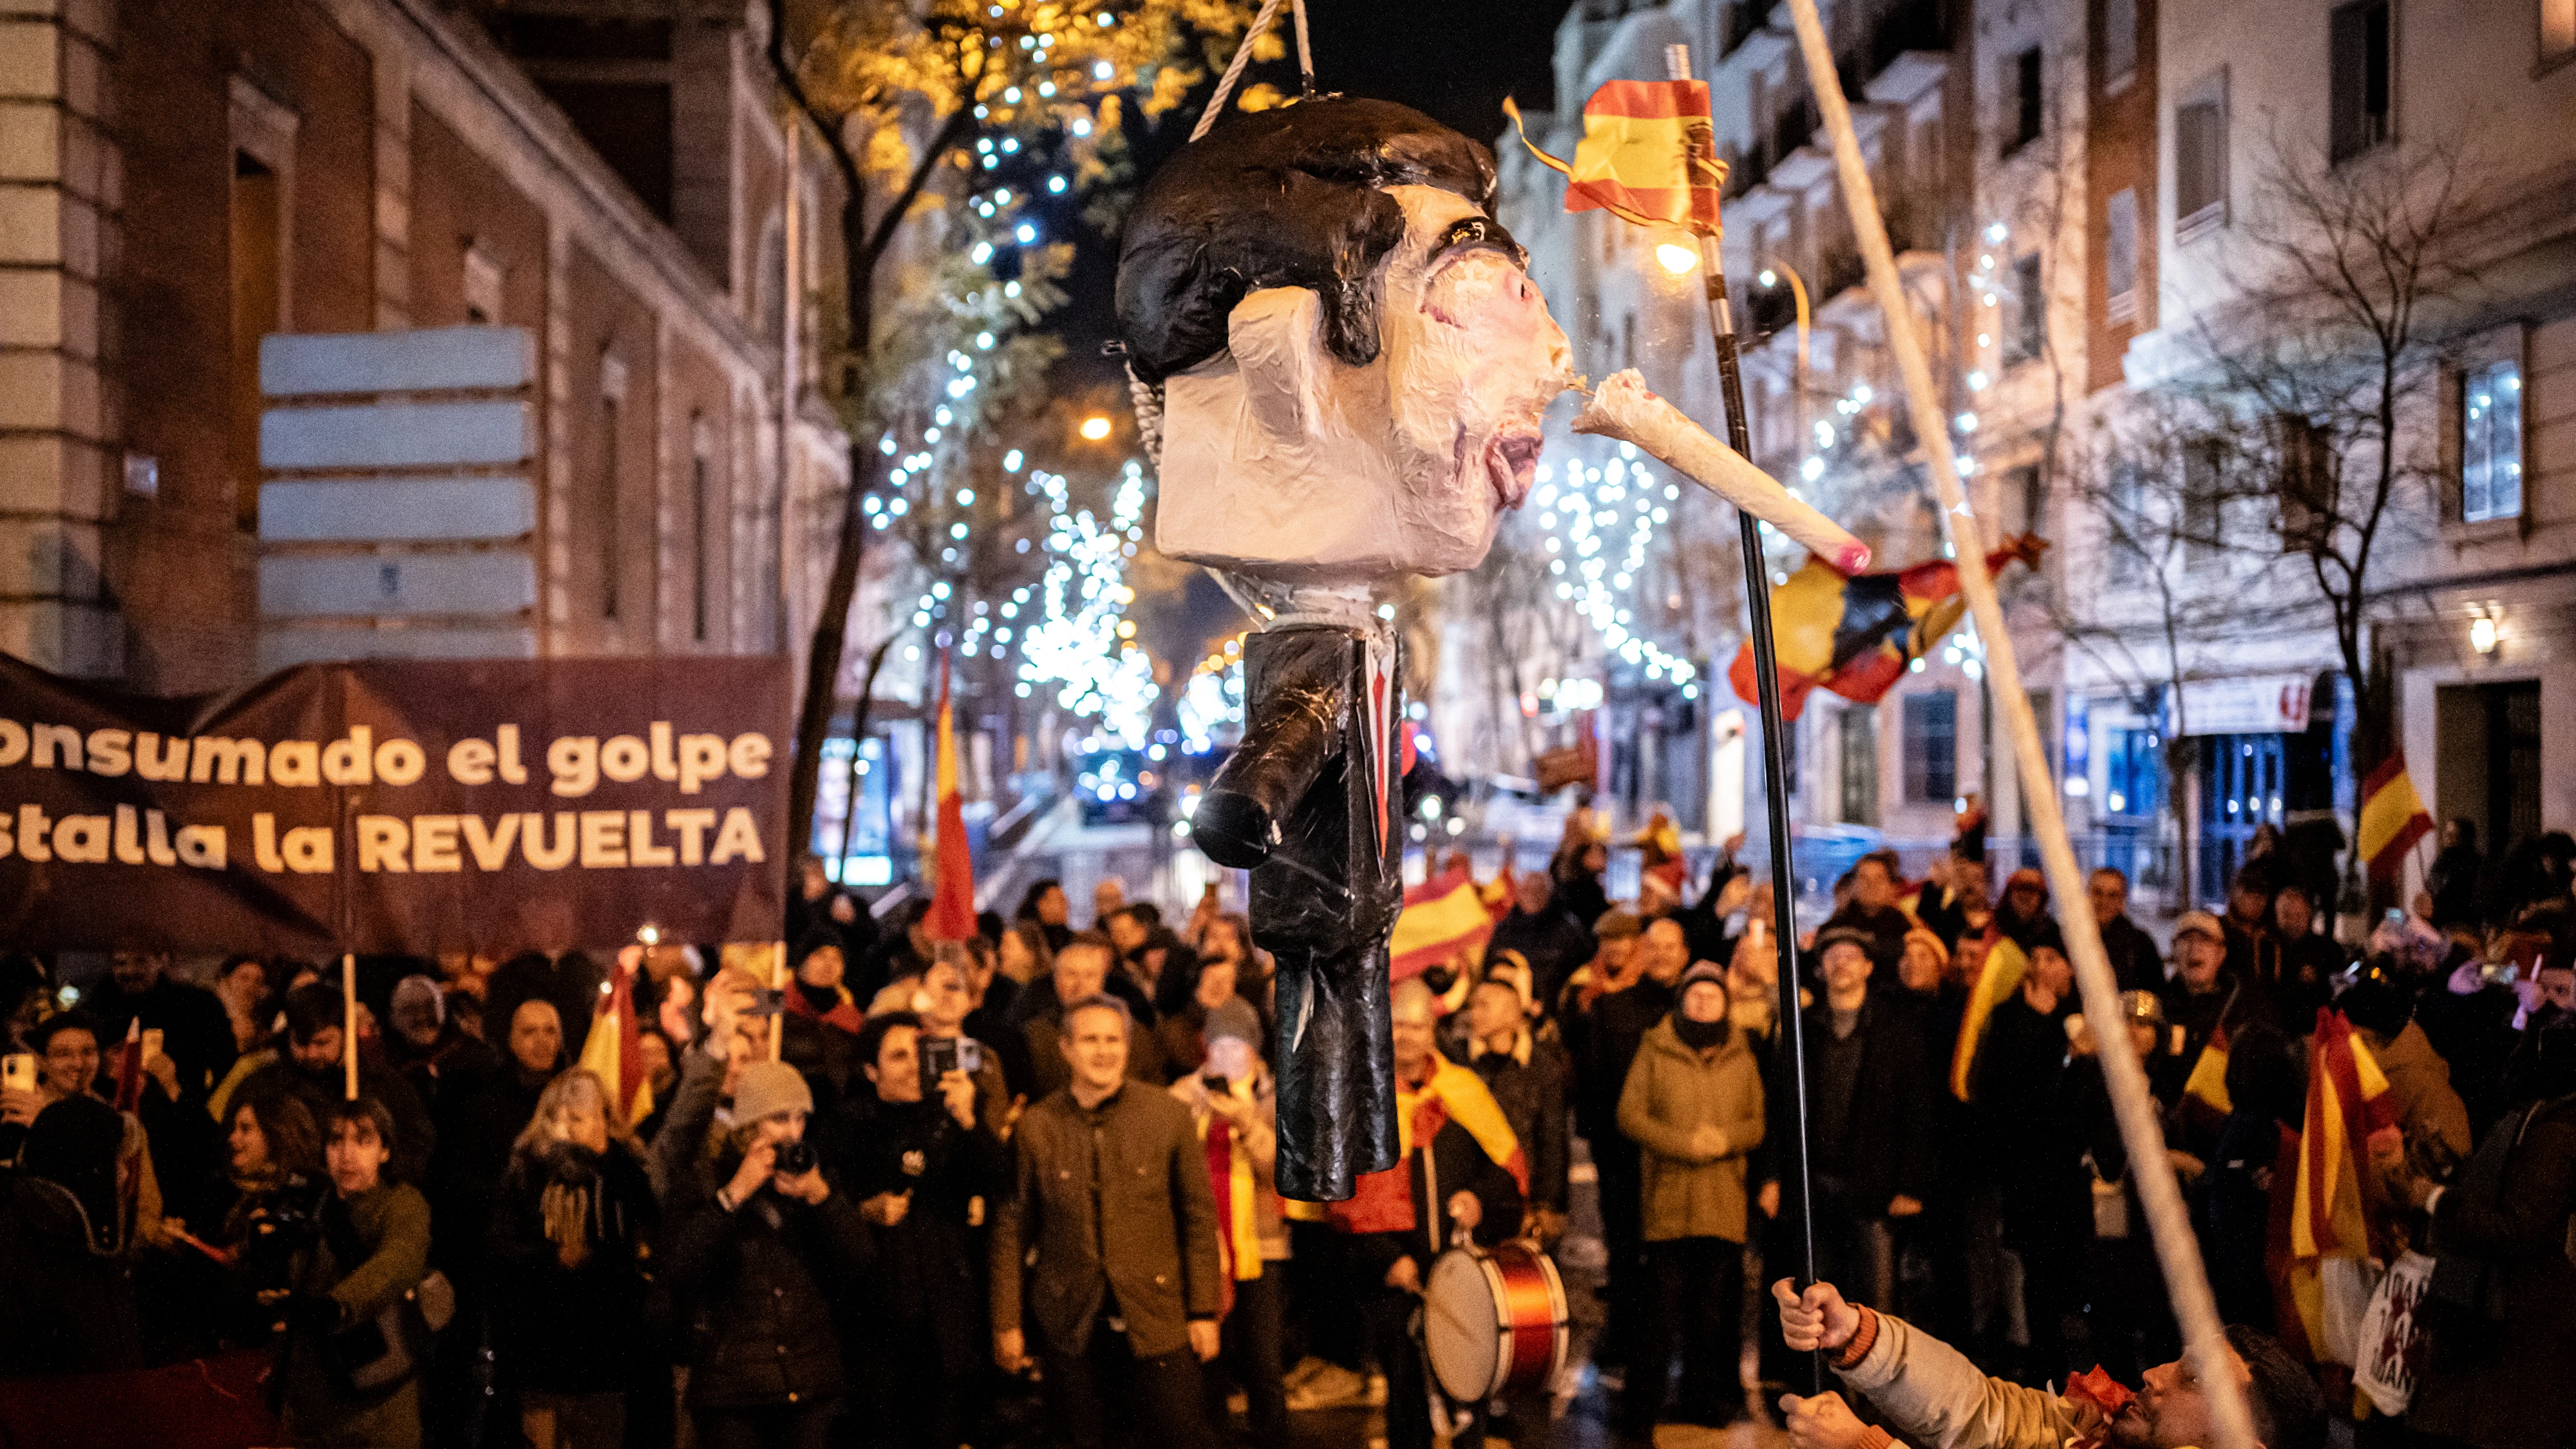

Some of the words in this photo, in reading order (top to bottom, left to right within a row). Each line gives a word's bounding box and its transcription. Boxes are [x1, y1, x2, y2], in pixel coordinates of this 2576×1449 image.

[0, 717, 426, 787] onsumado
[447, 723, 528, 786] el
[546, 720, 772, 797] golpe
[252, 811, 336, 874] la
[357, 806, 766, 873] REVUELTA
